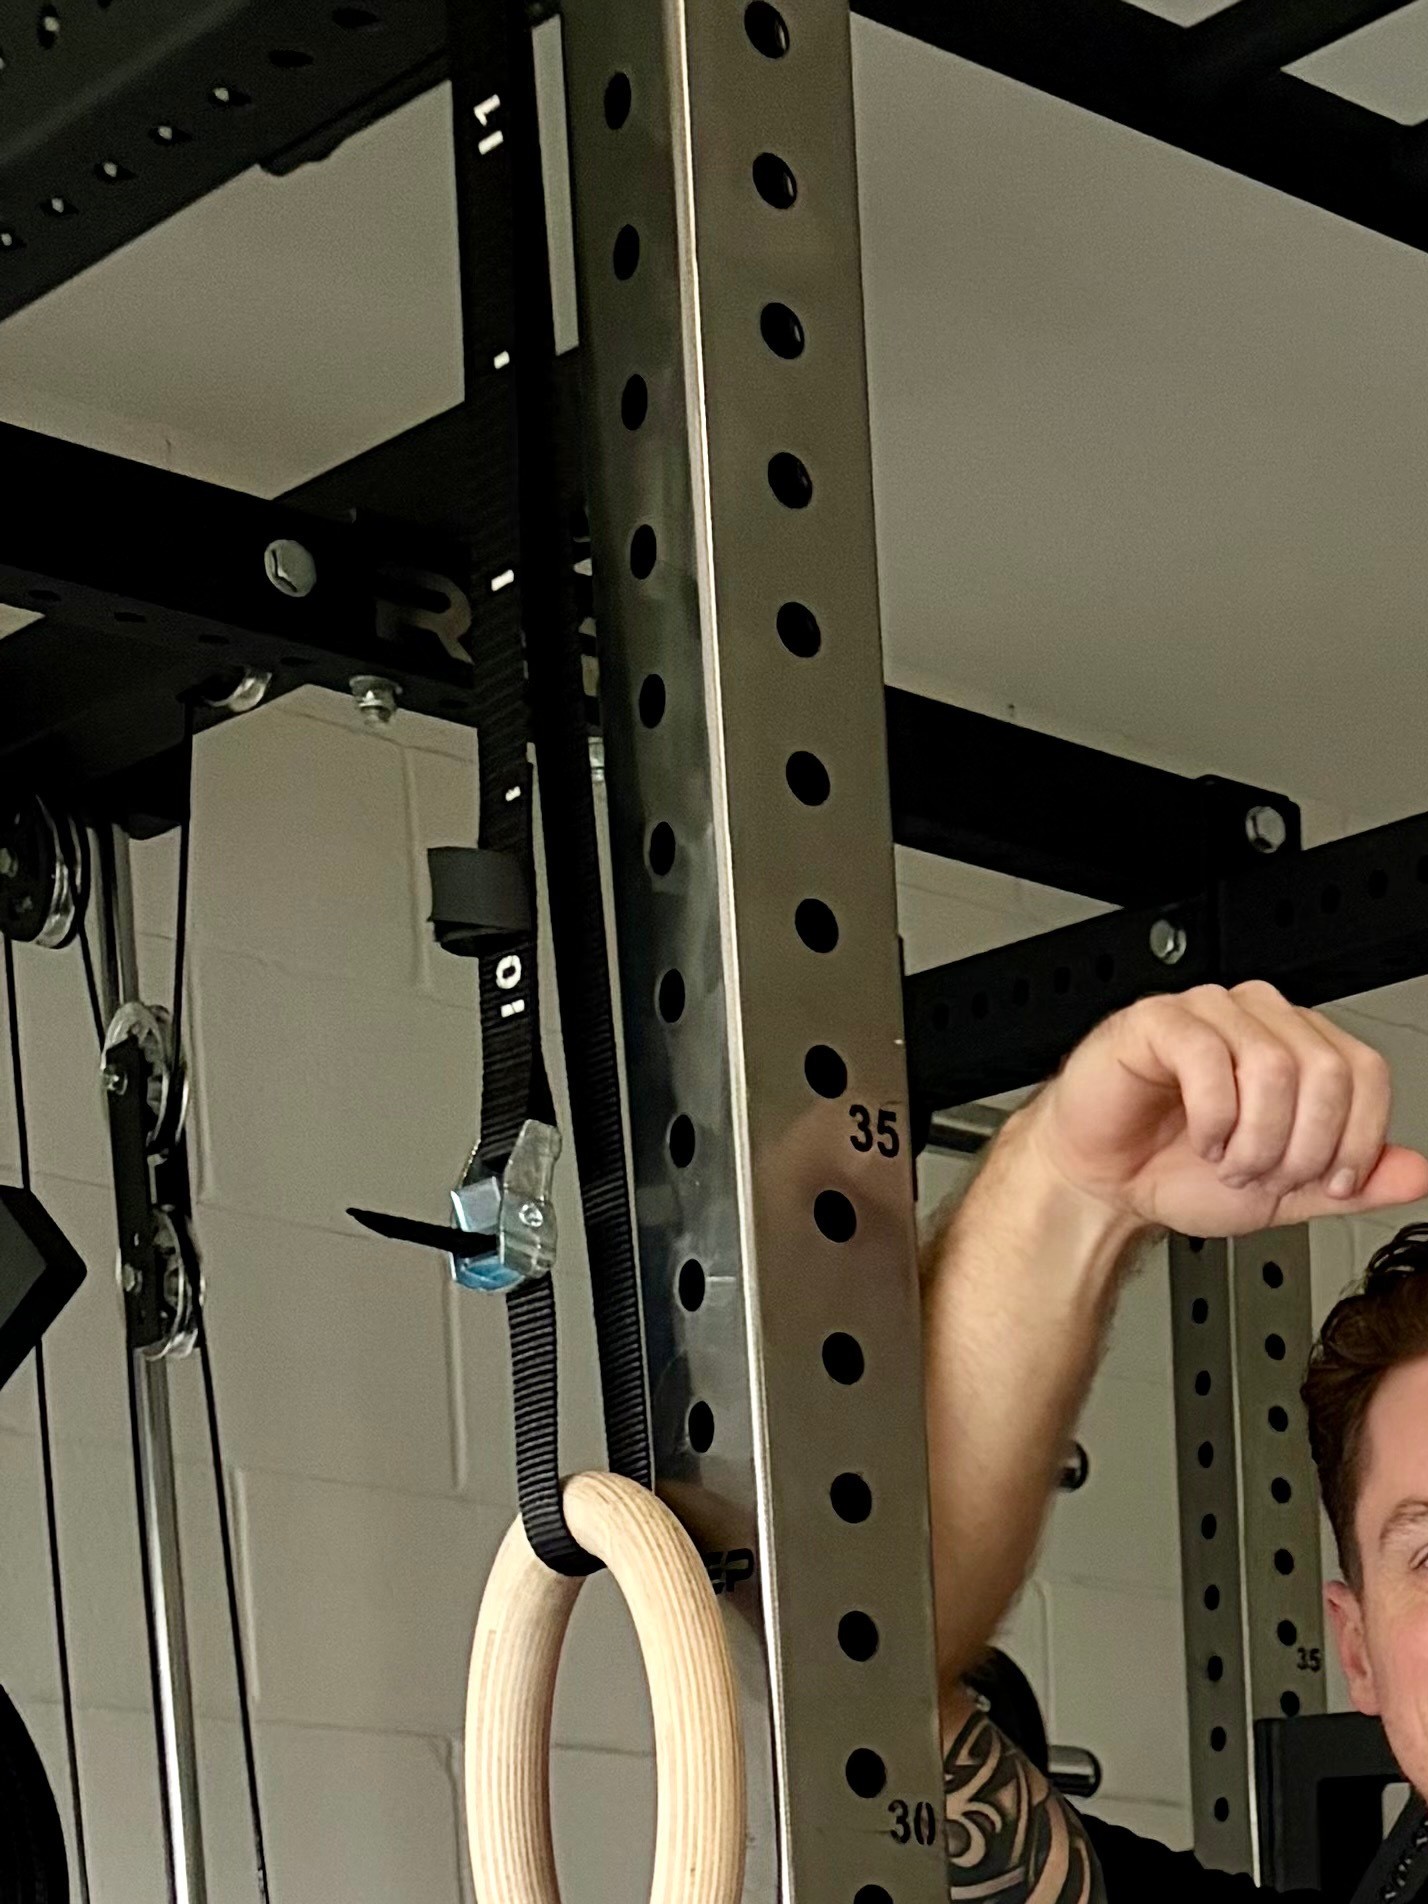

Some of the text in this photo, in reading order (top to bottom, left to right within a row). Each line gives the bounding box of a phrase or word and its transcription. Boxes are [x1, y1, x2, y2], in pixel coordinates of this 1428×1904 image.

[848, 1104, 900, 1158] 35
[700, 1547, 755, 1596] EP
[1297, 1646, 1321, 1673] 35
[887, 1799, 936, 1846] 30
